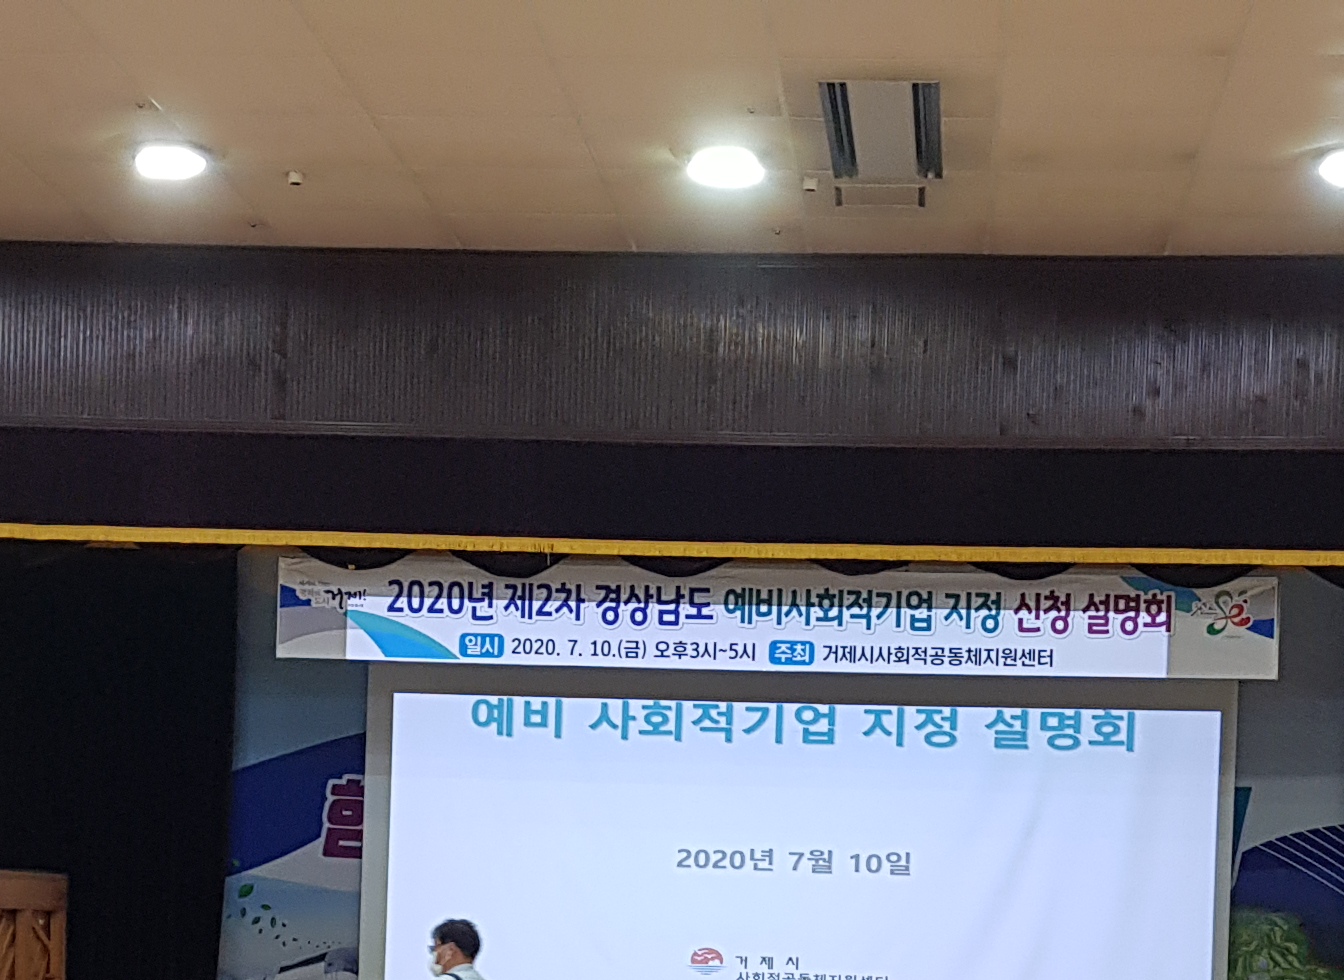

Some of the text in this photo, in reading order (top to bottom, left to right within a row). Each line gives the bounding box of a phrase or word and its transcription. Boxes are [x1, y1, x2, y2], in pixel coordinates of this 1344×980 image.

[386, 579, 1173, 636] 2020년 제2차 경상남도 예비사회적기업 지정 신청 설명회
[464, 635, 499, 656] 일시
[511, 637, 756, 661] 2020. 7. 10.(금) 오후3시~5시
[773, 643, 810, 663] 주최
[822, 645, 1055, 668] 거제시사회적공동체지원센터
[471, 697, 1136, 752] 예비 사회적기업 지정 설명회
[675, 848, 912, 877] 2020년 7월 10일
